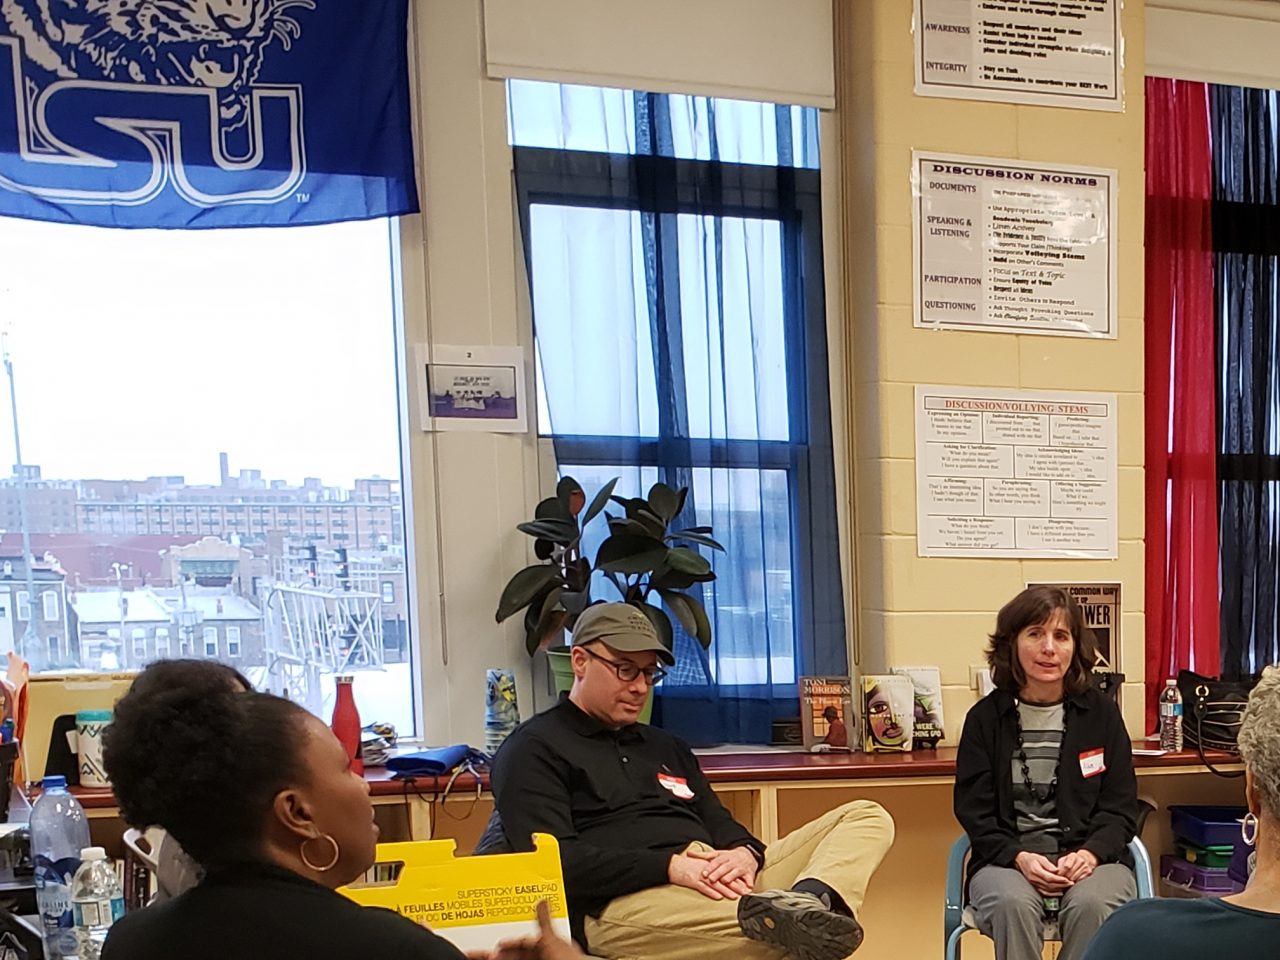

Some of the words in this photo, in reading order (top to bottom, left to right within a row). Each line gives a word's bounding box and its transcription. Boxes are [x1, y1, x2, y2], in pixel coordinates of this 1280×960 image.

[925, 23, 970, 34] AWARENESS
[925, 61, 967, 72] INTEGRITY
[932, 164, 1034, 180] DISCUSSION
[1040, 174, 1097, 186] NORMS
[929, 182, 976, 192] DOCUMENTS
[927, 216, 964, 225] SPEAKING
[930, 228, 969, 238] LISTENING
[1025, 250, 1060, 259] Volleying
[924, 274, 981, 285] PARTICIPATION
[1046, 271, 1066, 281] Topic
[924, 300, 976, 311] QUESTIONING
[945, 400, 1054, 412] DISCUSSION/VOLLYING
[1058, 405, 1088, 413] STEMS
[1070, 587, 1101, 595] COMMON
[804, 685, 851, 695] MORRISON
[457, 887, 512, 899] SUPERSTICKY
[404, 902, 445, 914] FEUILLES
[447, 899, 483, 910] MOBILES
[485, 897, 512, 907] SUPER
[441, 911, 454, 921] DE
[455, 909, 484, 919] HOJAS
